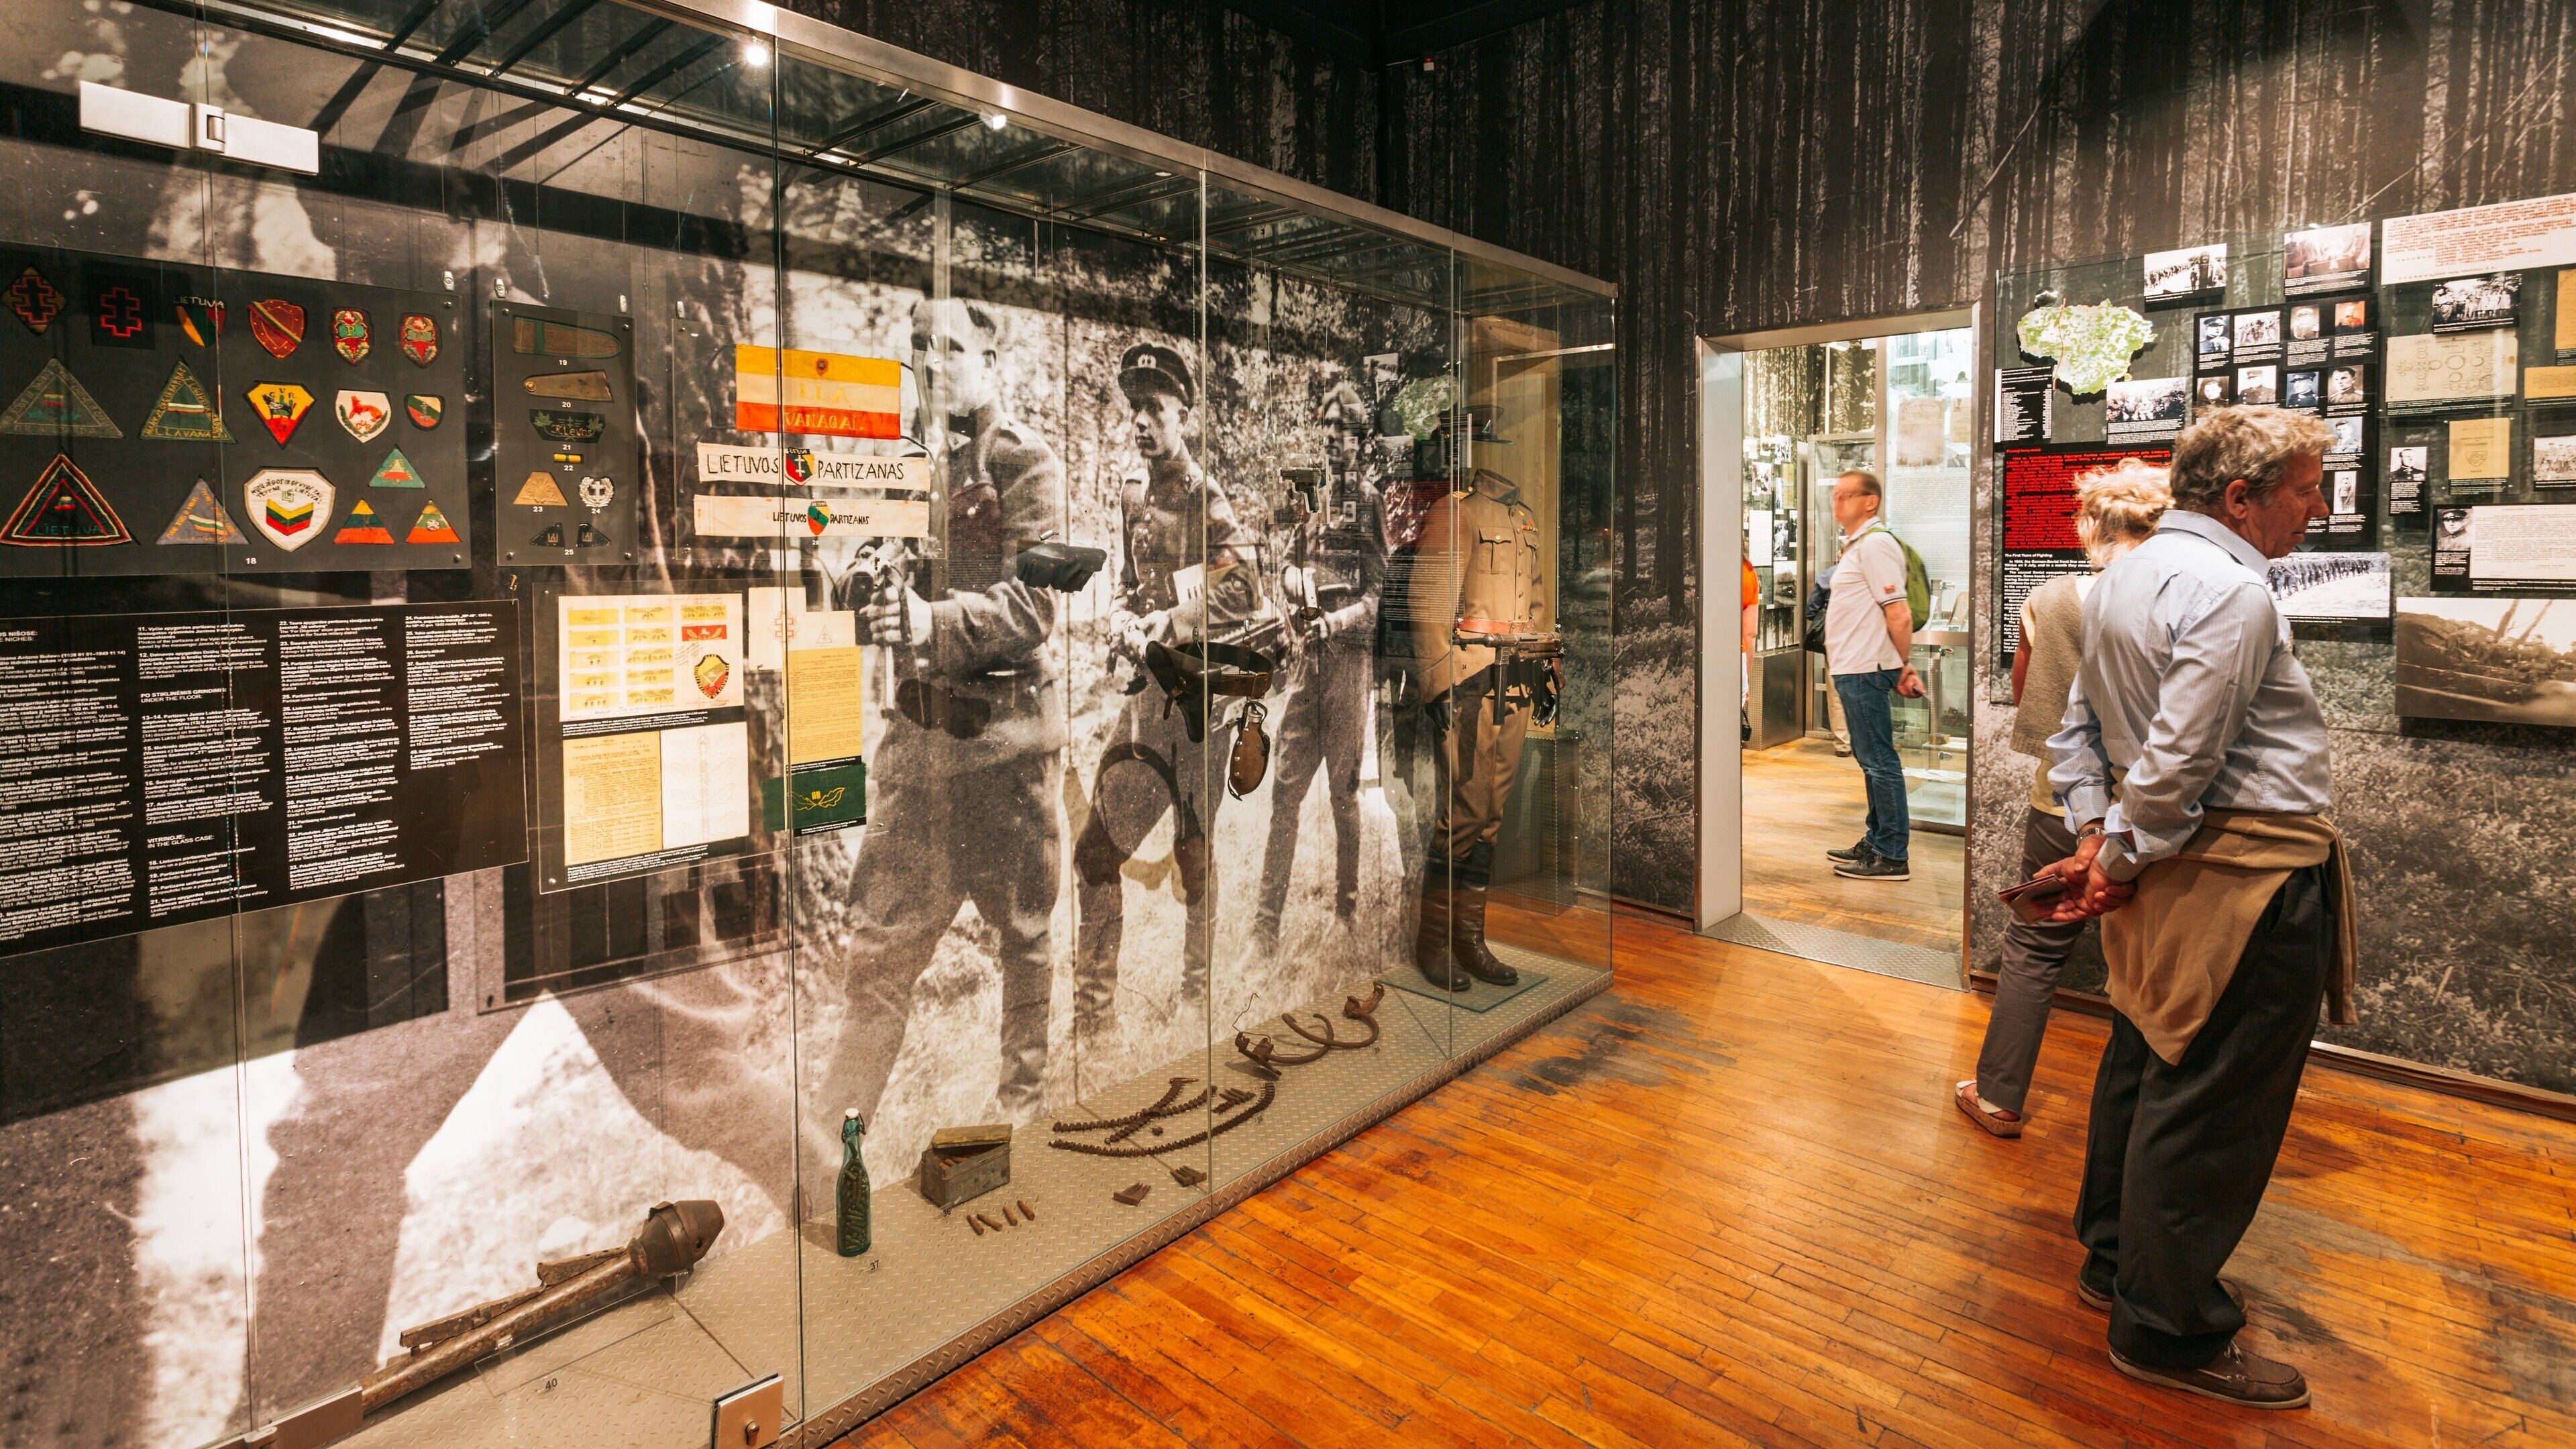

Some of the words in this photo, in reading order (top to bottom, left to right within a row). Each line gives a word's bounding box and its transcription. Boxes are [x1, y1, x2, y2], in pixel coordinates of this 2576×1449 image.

[800, 383, 850, 403] LLA
[707, 454, 779, 474] LIETUVOS
[818, 461, 904, 480] PARTIZANAS
[773, 512, 807, 523] LIETUVOS
[830, 514, 869, 524] PARTIZANAS
[870, 1259, 879, 1270] 37
[545, 1378, 558, 1391] 40
